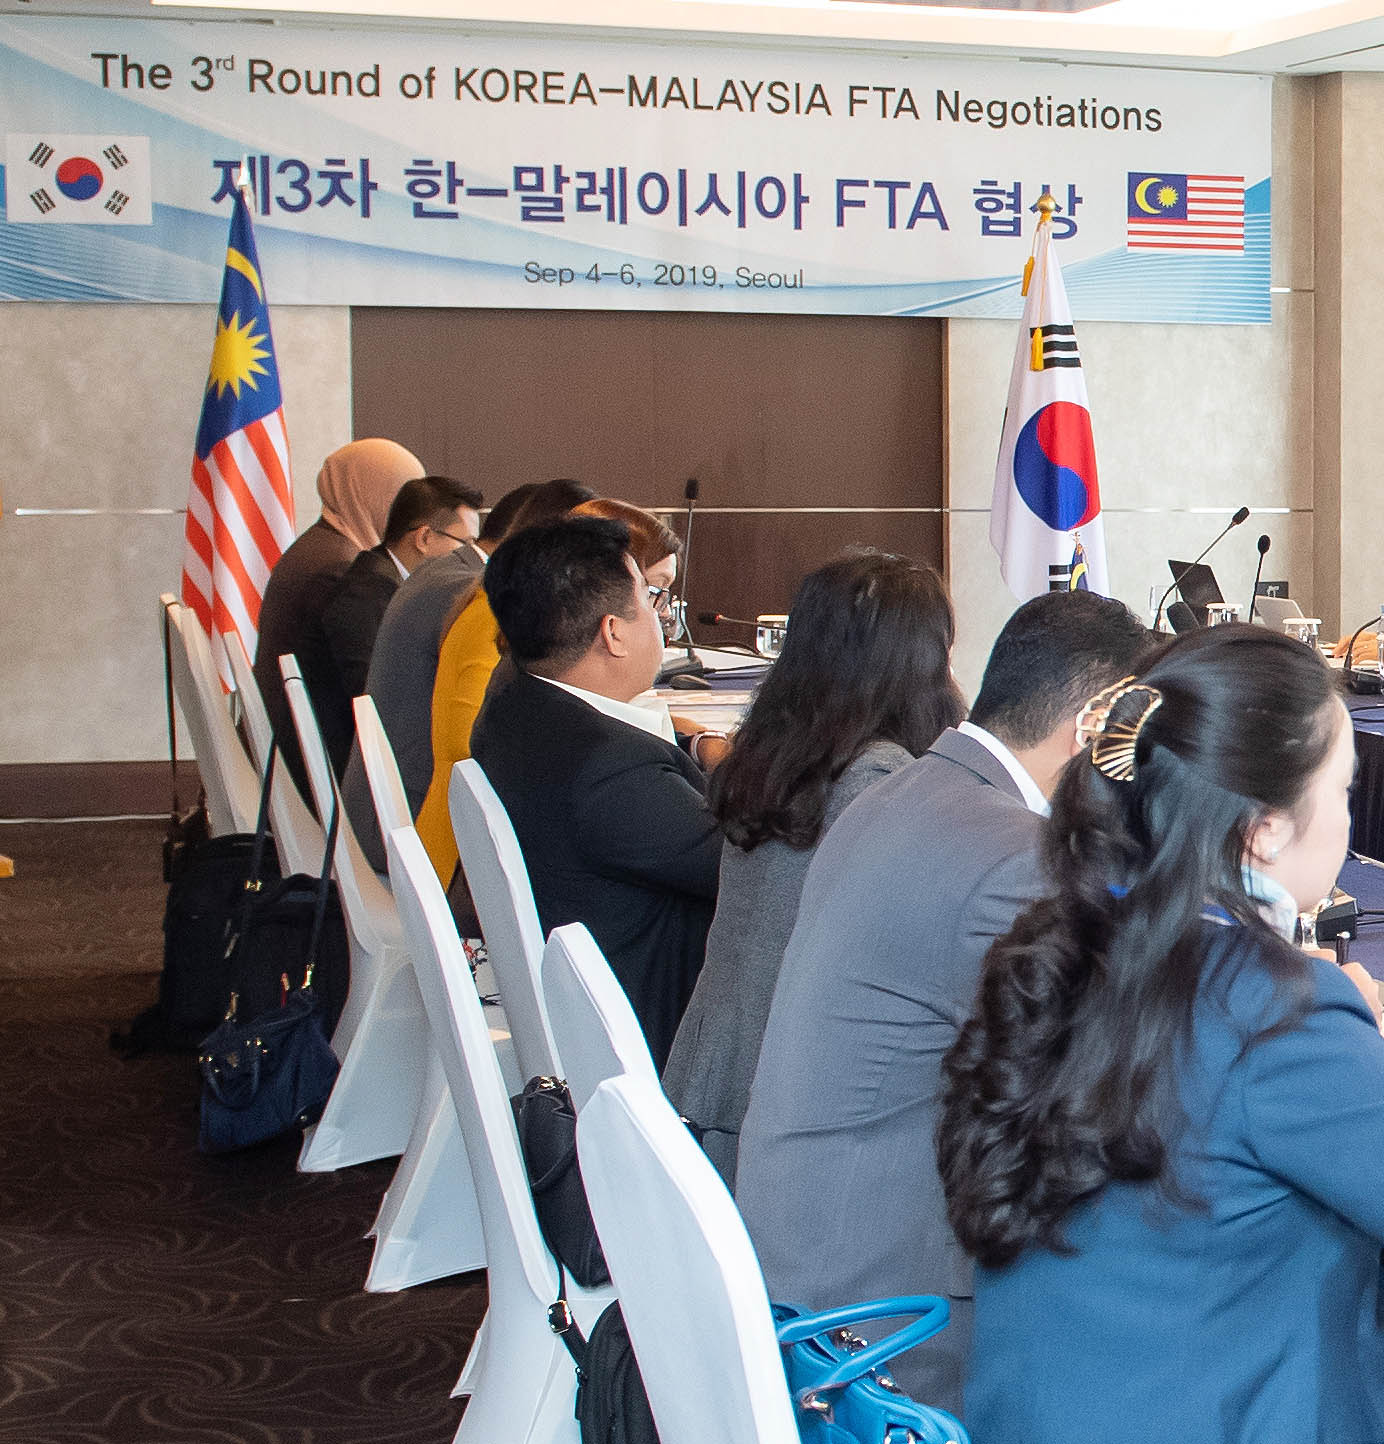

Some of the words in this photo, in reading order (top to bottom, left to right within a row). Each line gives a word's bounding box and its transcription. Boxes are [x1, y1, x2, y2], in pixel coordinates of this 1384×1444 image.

[91, 53, 173, 90] The
[191, 55, 235, 92] 3rd
[249, 59, 380, 98] Round
[399, 66, 435, 100] of
[849, 86, 920, 120] FTA
[937, 90, 1162, 132] Negotiations
[210, 155, 378, 218] 제3차
[836, 179, 949, 231] FTA
[973, 180, 1083, 240] 협상
[524, 261, 575, 287] Sep
[585, 263, 642, 289] 4-6,
[654, 264, 725, 290] 2019,
[735, 267, 804, 291] Seoul
